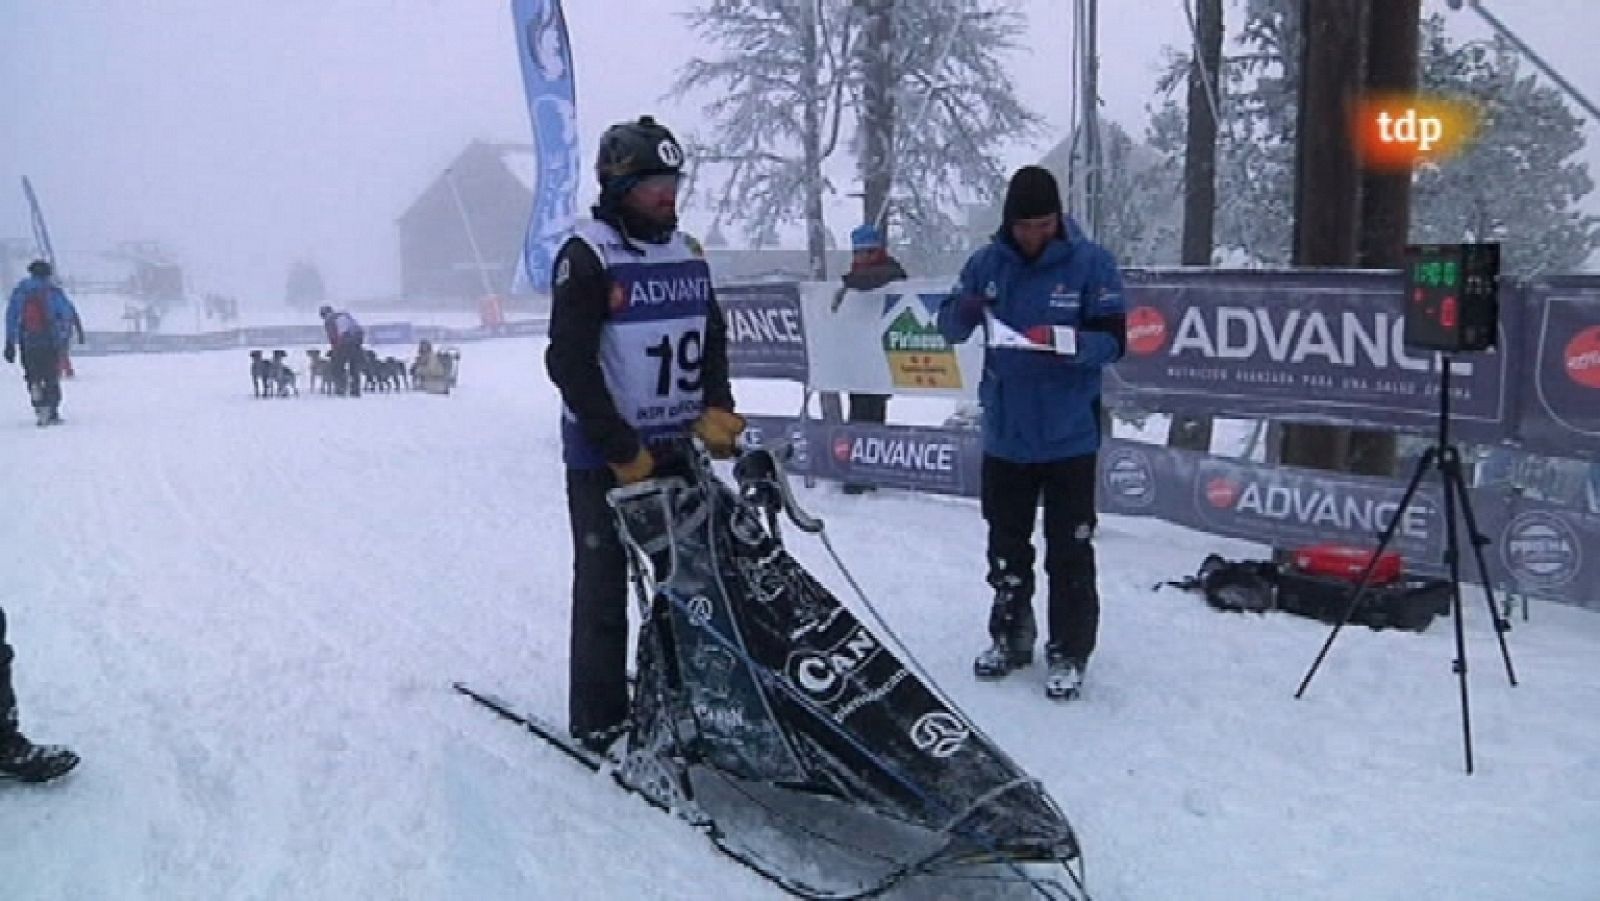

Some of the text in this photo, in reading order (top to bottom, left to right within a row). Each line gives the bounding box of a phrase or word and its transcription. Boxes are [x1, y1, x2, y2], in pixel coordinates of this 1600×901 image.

[645, 331, 703, 398] 19
[850, 437, 953, 470] ADVANCE
[1235, 482, 1428, 539] ADVANCE
